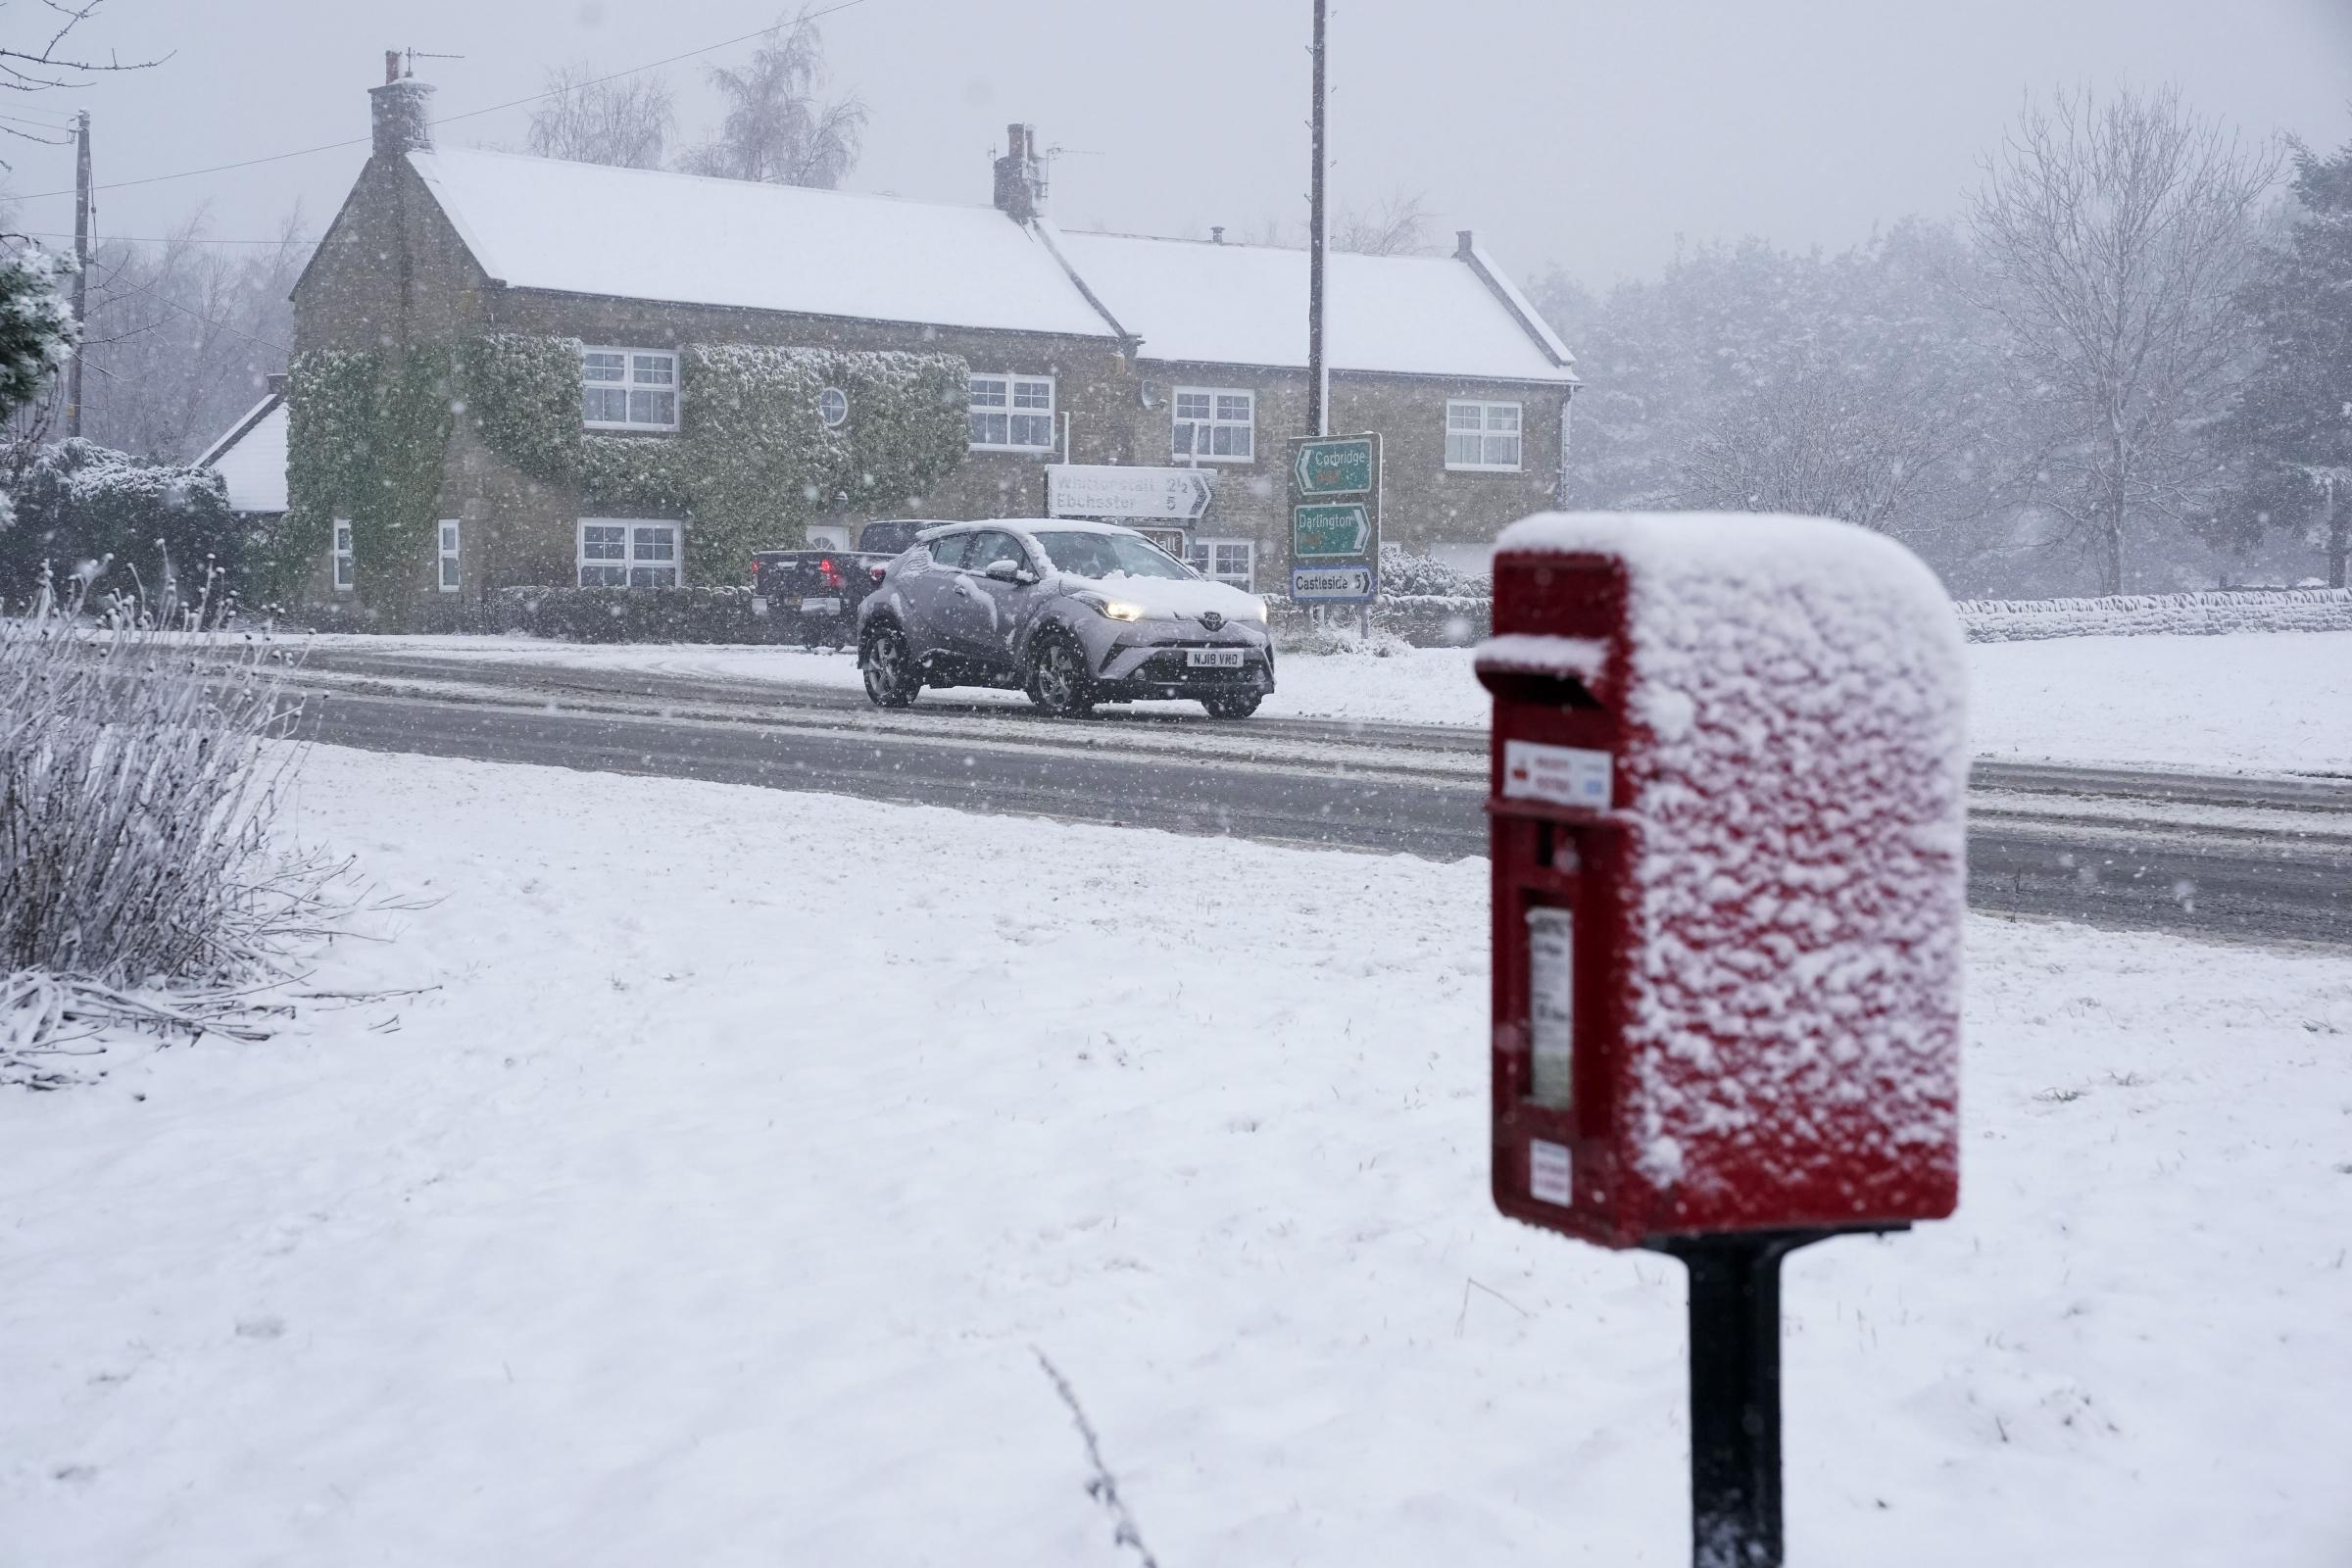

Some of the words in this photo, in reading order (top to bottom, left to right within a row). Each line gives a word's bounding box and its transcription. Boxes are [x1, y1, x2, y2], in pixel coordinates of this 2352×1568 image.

[1315, 450, 1365, 466] Corbridge
[1166, 495, 1176, 511] 5
[1298, 514, 1352, 530] Darlington
[1296, 575, 1348, 590] Castleside
[1354, 574, 1361, 590] 5
[1194, 654, 1216, 665] NJ18
